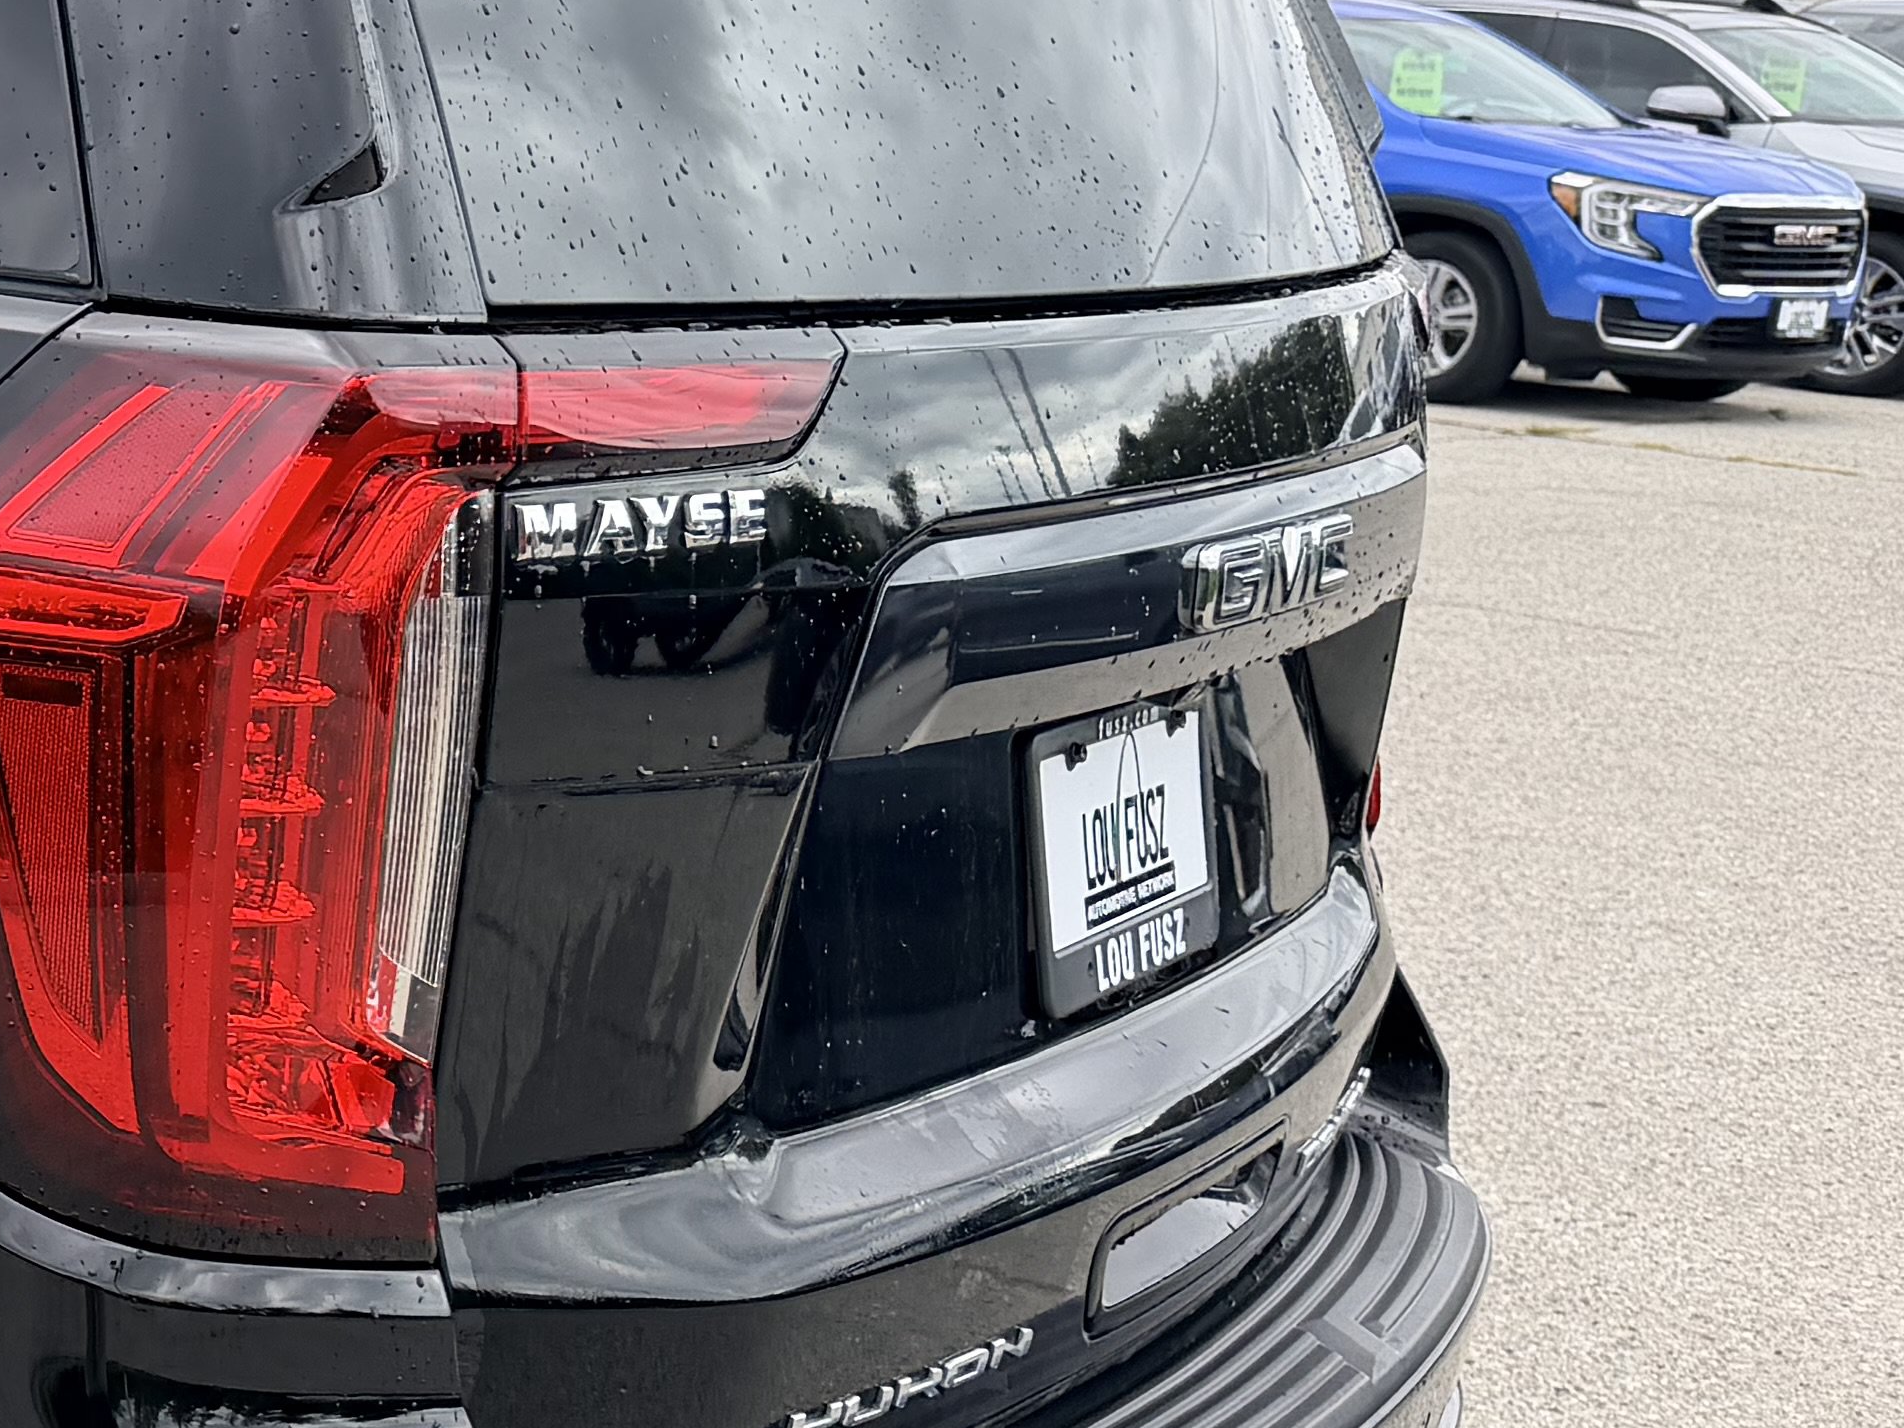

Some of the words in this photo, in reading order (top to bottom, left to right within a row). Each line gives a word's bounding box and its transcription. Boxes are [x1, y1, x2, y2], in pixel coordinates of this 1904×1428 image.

[1773, 224, 1839, 246] GMC
[513, 488, 768, 561] MAYSE
[1182, 513, 1354, 634] GMC
[1082, 801, 1119, 890] LOU
[1124, 783, 1169, 875] FUSZ
[1094, 930, 1135, 993] LOU
[1138, 906, 1187, 972] FUSZ
